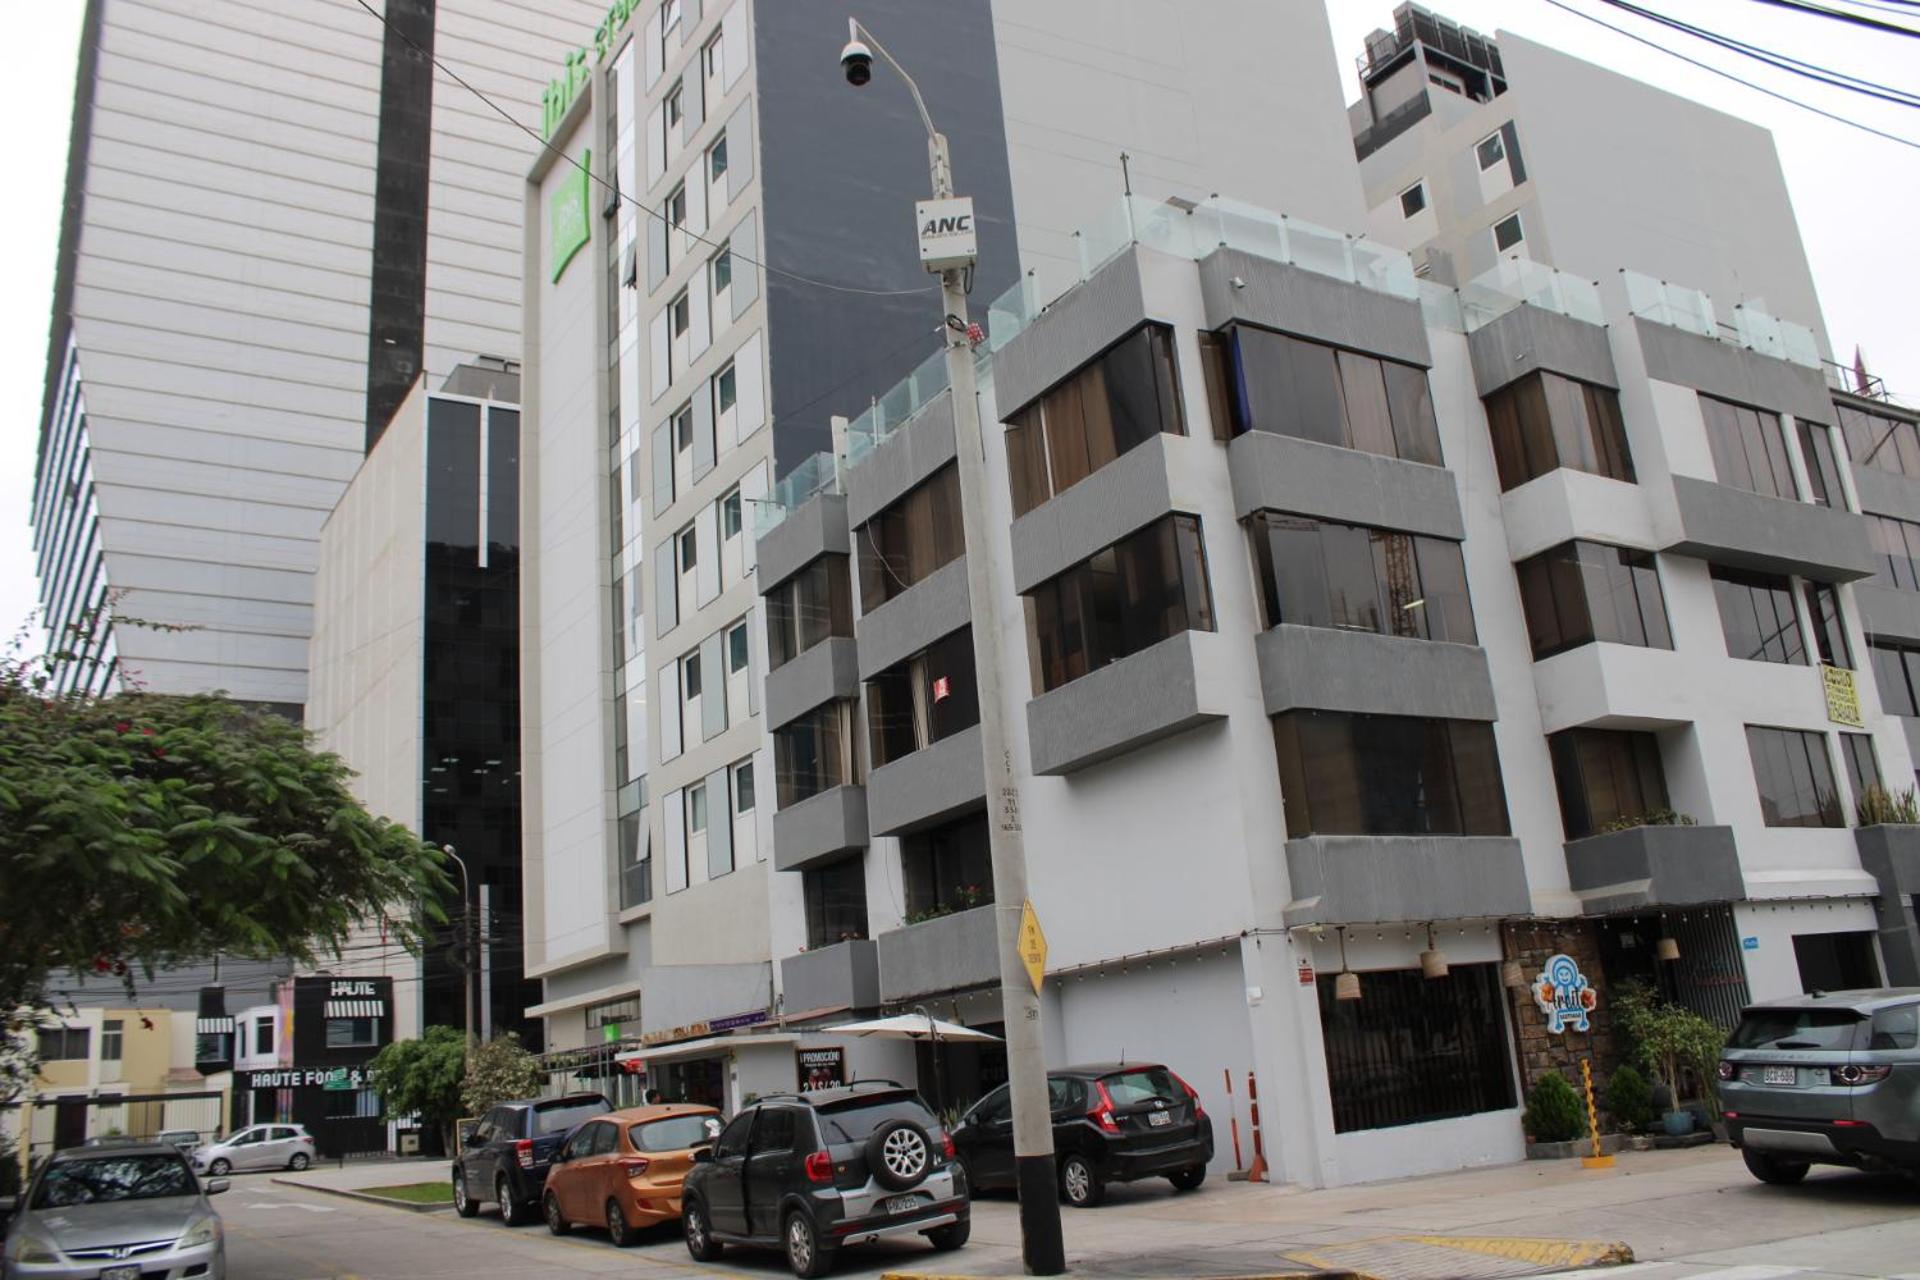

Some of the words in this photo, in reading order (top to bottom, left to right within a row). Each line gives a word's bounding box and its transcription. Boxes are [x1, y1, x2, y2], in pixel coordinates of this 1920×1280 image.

[921, 215, 971, 235] ANC
[330, 981, 376, 997] HAUTE
[251, 1072, 299, 1087] HAUTE
[351, 1070, 362, 1082] &
